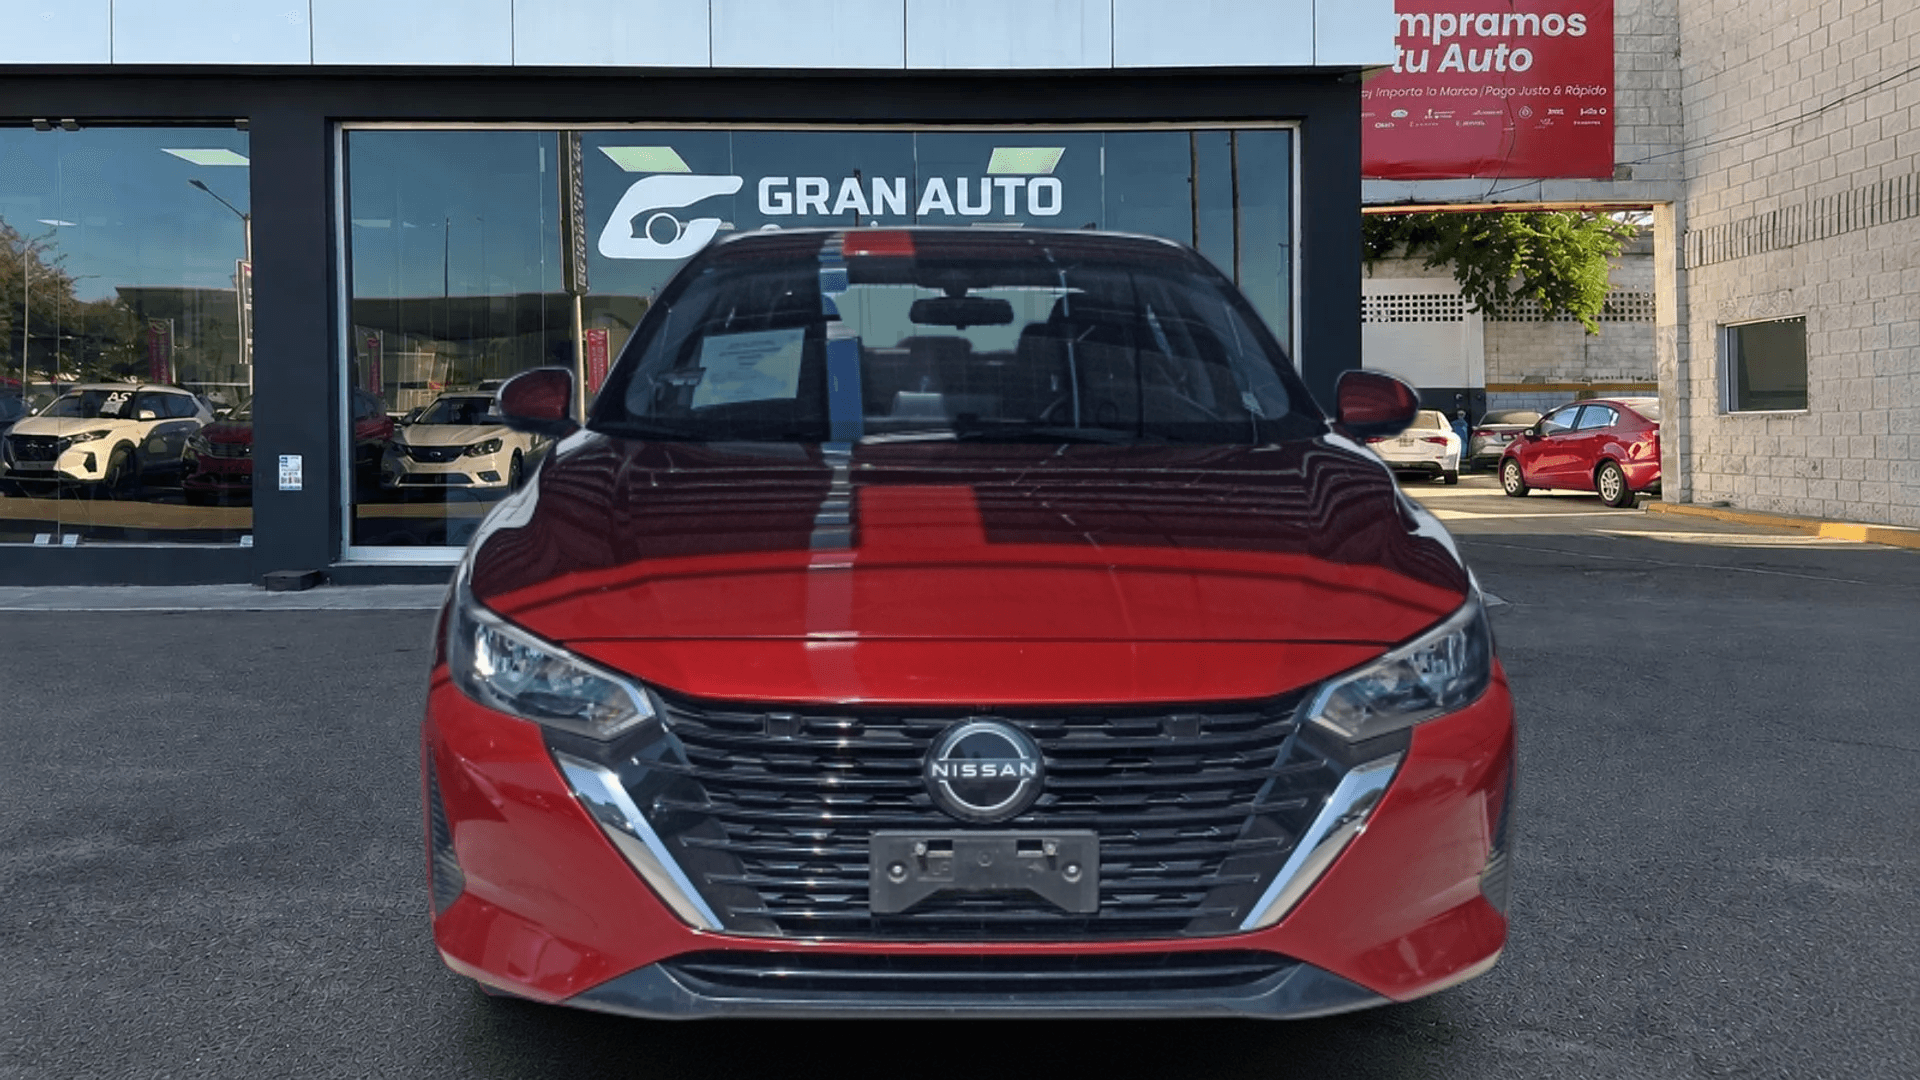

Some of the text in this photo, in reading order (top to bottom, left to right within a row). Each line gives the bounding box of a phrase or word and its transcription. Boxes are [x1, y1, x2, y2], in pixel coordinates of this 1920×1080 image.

[1392, 43, 1533, 73] tu Auto
[1376, 87, 1423, 99] Importa
[1426, 86, 1437, 97] la
[1440, 86, 1478, 97] Marca
[1519, 86, 1550, 96] Justo
[1552, 86, 1562, 96] &
[1565, 84, 1607, 98] Rápido
[758, 176, 1062, 215] GRAN AUTO
[931, 762, 1037, 777] NISSAN
